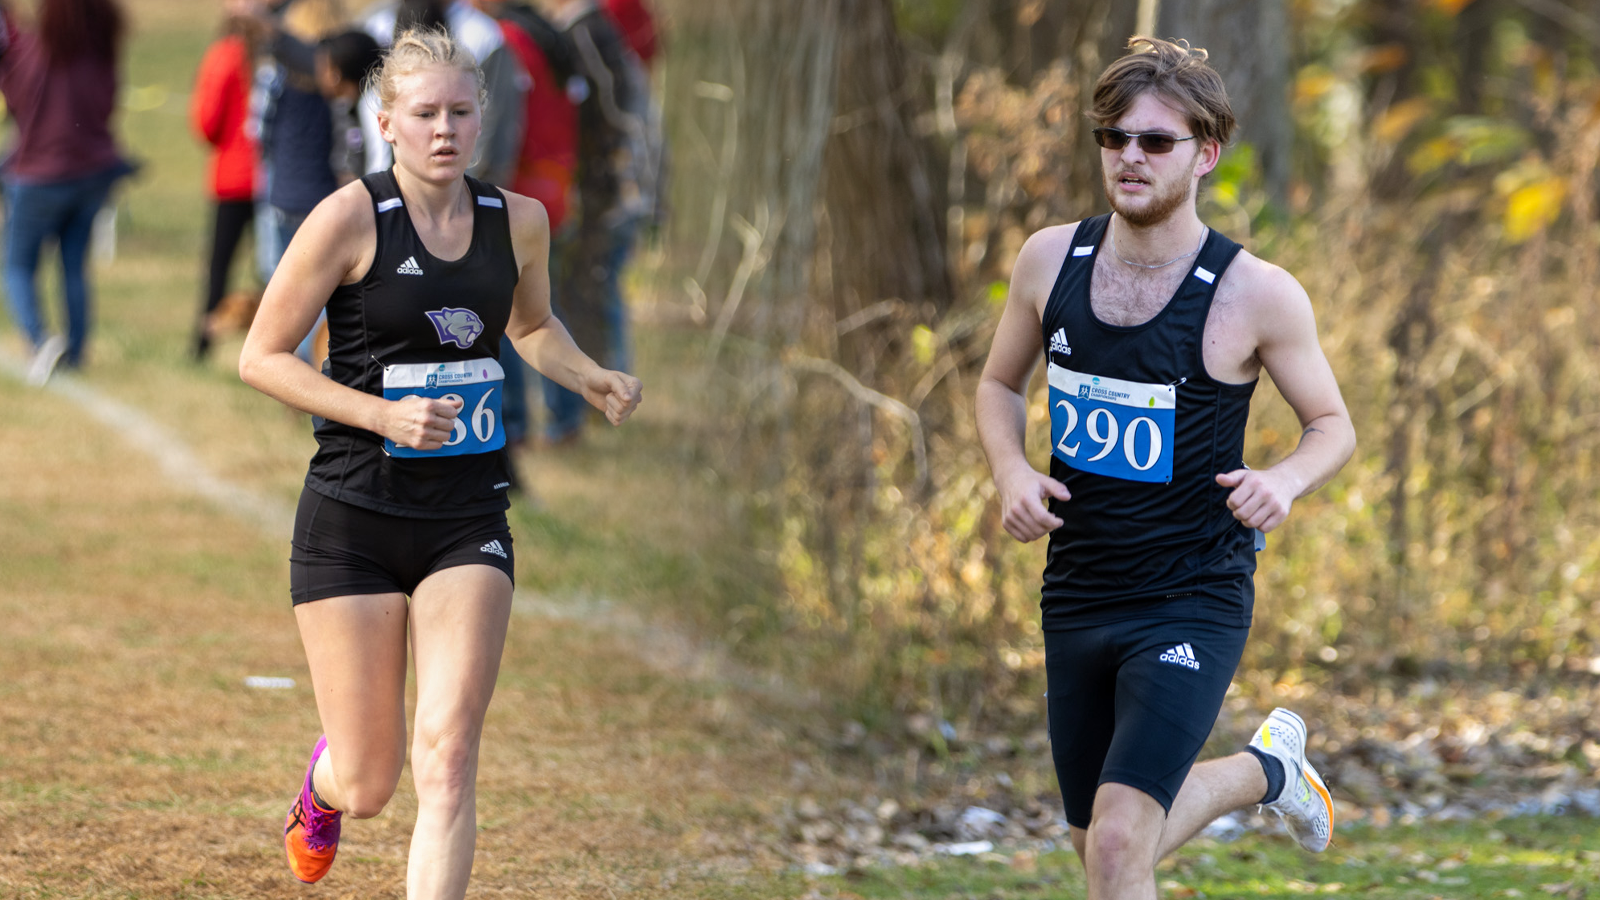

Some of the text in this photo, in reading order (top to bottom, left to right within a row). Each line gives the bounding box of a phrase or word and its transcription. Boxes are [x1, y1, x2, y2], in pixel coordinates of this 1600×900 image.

[397, 266, 424, 275] adidas
[1091, 387, 1108, 396] CROSS
[1108, 390, 1131, 400] COUNTRY
[395, 387, 495, 448] 86
[1055, 399, 1163, 471] 290
[480, 546, 508, 559] adidas
[1159, 653, 1200, 670] adidas
